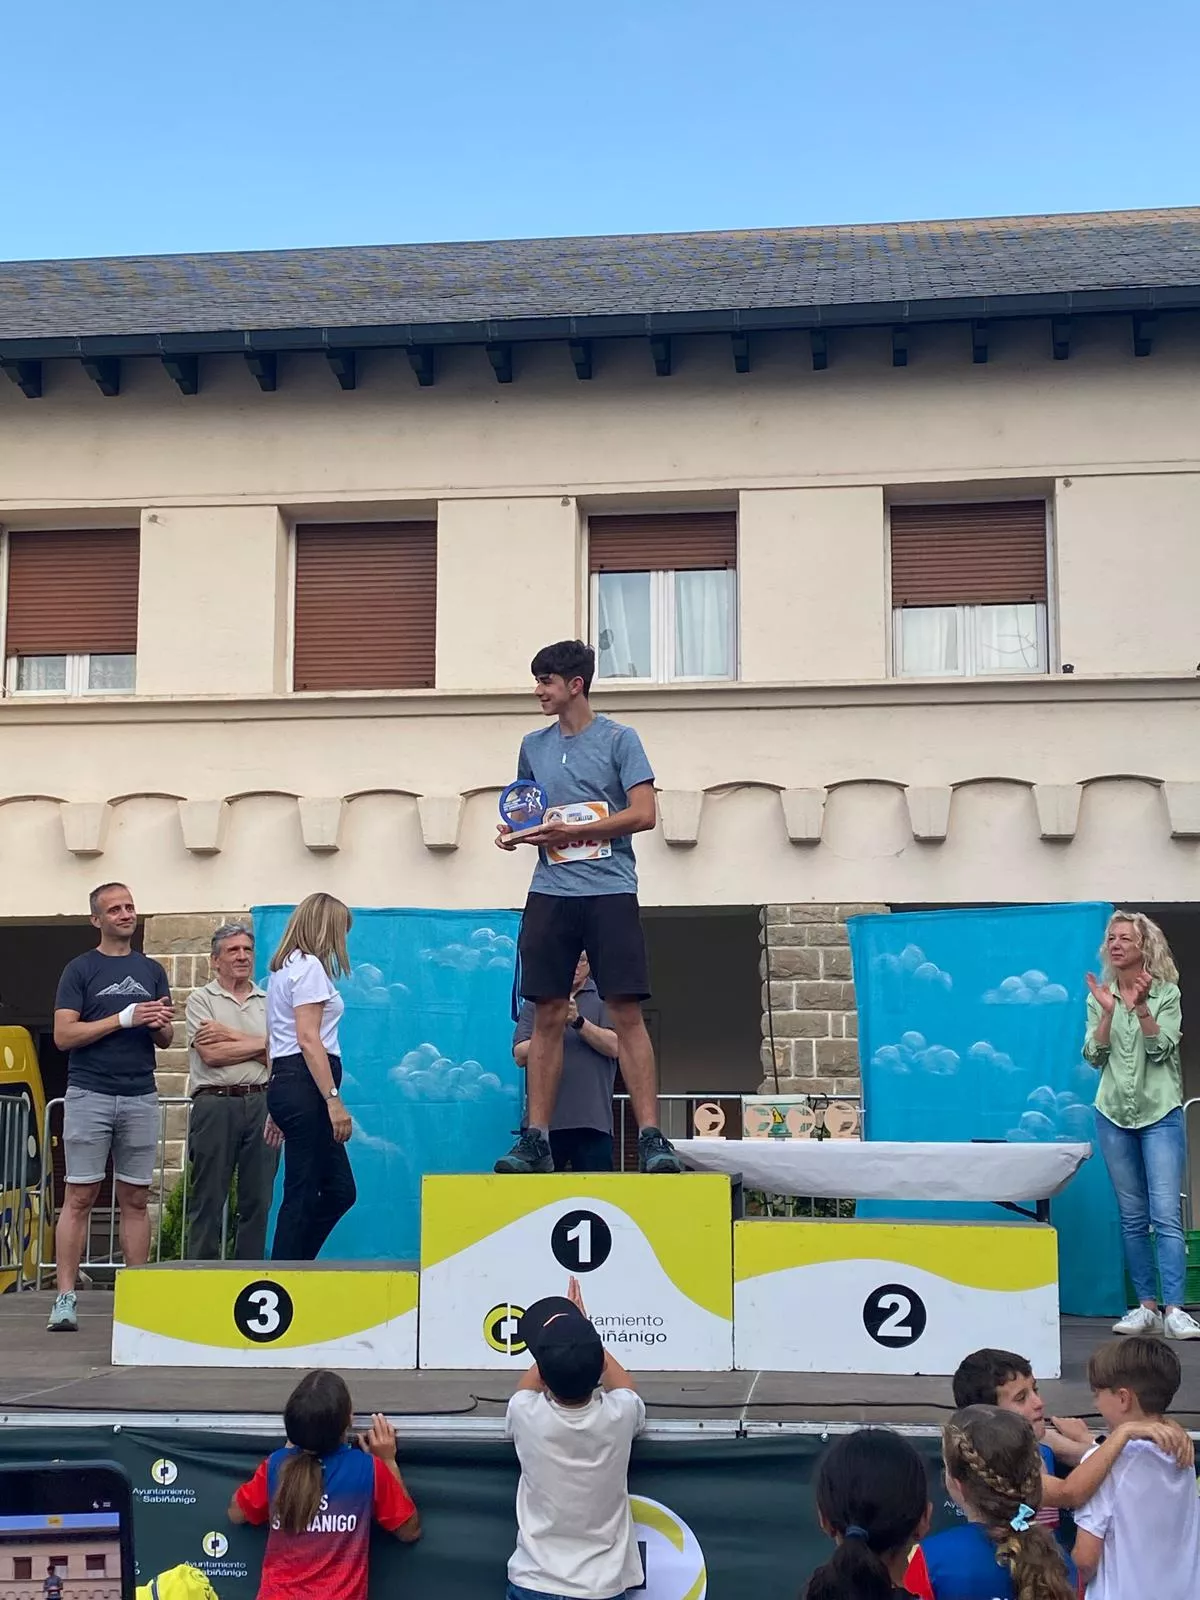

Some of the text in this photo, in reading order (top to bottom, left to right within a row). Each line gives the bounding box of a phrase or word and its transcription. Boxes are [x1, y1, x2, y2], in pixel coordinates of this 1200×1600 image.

[566, 1219, 592, 1263] 1
[246, 1289, 280, 1334] 3
[588, 1313, 664, 1327] tamiento
[877, 1293, 912, 1338] 2
[601, 1329, 668, 1346] iñánigo
[132, 1487, 195, 1497] Ayuntamiento
[142, 1495, 197, 1504] Sabiñánigo
